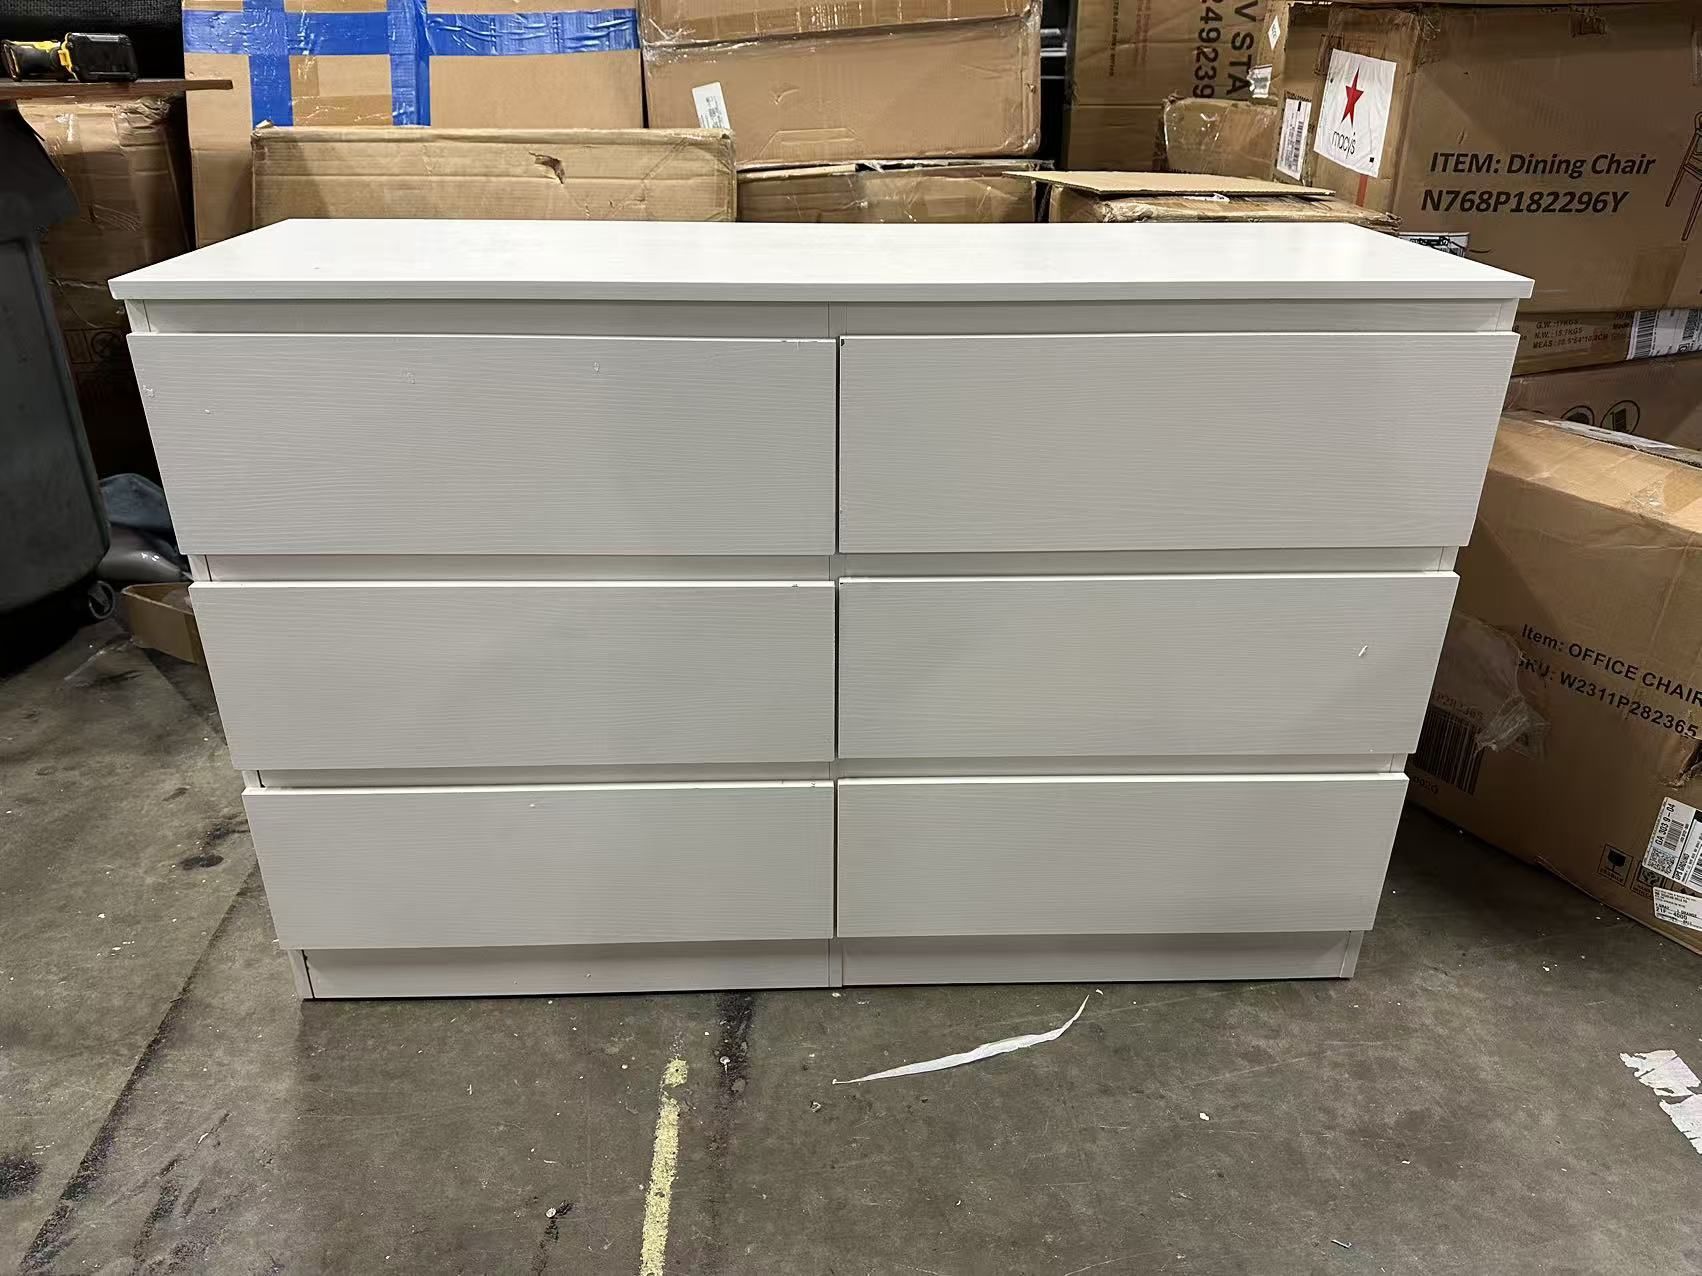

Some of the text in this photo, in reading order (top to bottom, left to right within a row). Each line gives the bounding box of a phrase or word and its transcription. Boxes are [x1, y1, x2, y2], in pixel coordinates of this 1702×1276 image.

[1192, 0, 1222, 98] 49239
[1226, 31, 1254, 98] STA
[1430, 152, 1657, 179] ITEM: Dining Chair
[1421, 189, 1630, 213] N768P182296Y
[1521, 624, 1702, 707] Item: OFFICE CHAIR
[1560, 671, 1699, 738] W2311P282365
